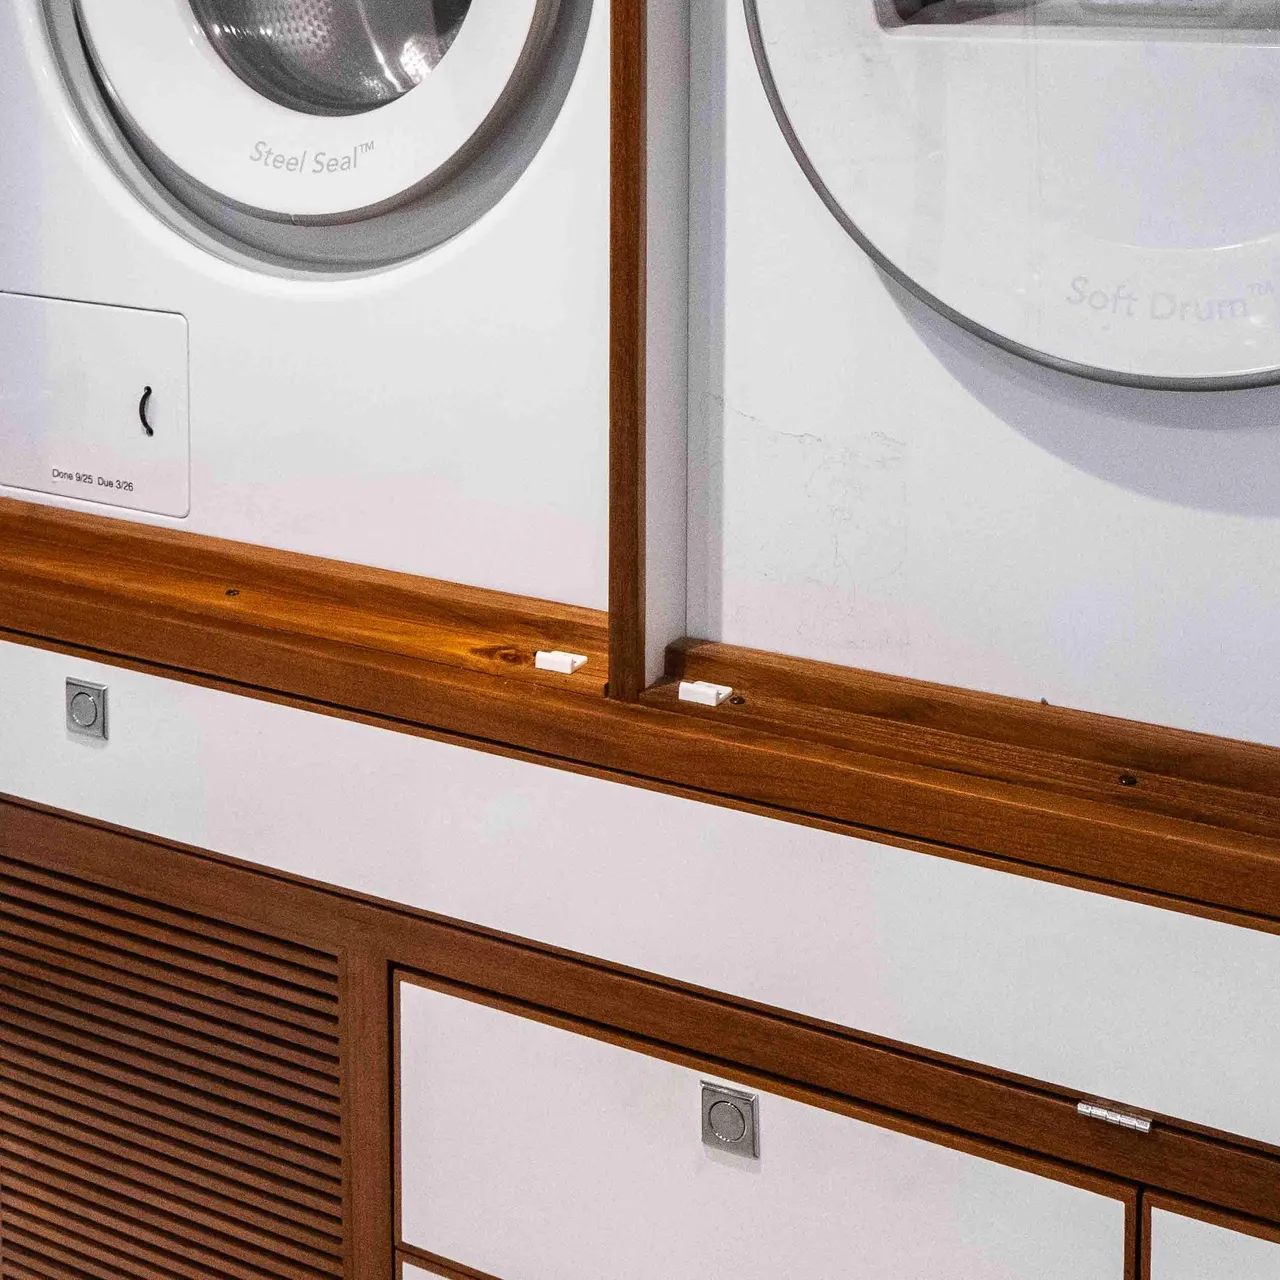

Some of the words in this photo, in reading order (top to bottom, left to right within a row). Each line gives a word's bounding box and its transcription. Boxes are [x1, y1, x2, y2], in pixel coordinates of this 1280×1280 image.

[249, 140, 307, 173] Steel
[1065, 275, 1138, 317] Soft
[52, 468, 73, 480] Done
[75, 472, 93, 484] 9/25
[97, 476, 113, 488] Due
[115, 479, 134, 491] 3/26
